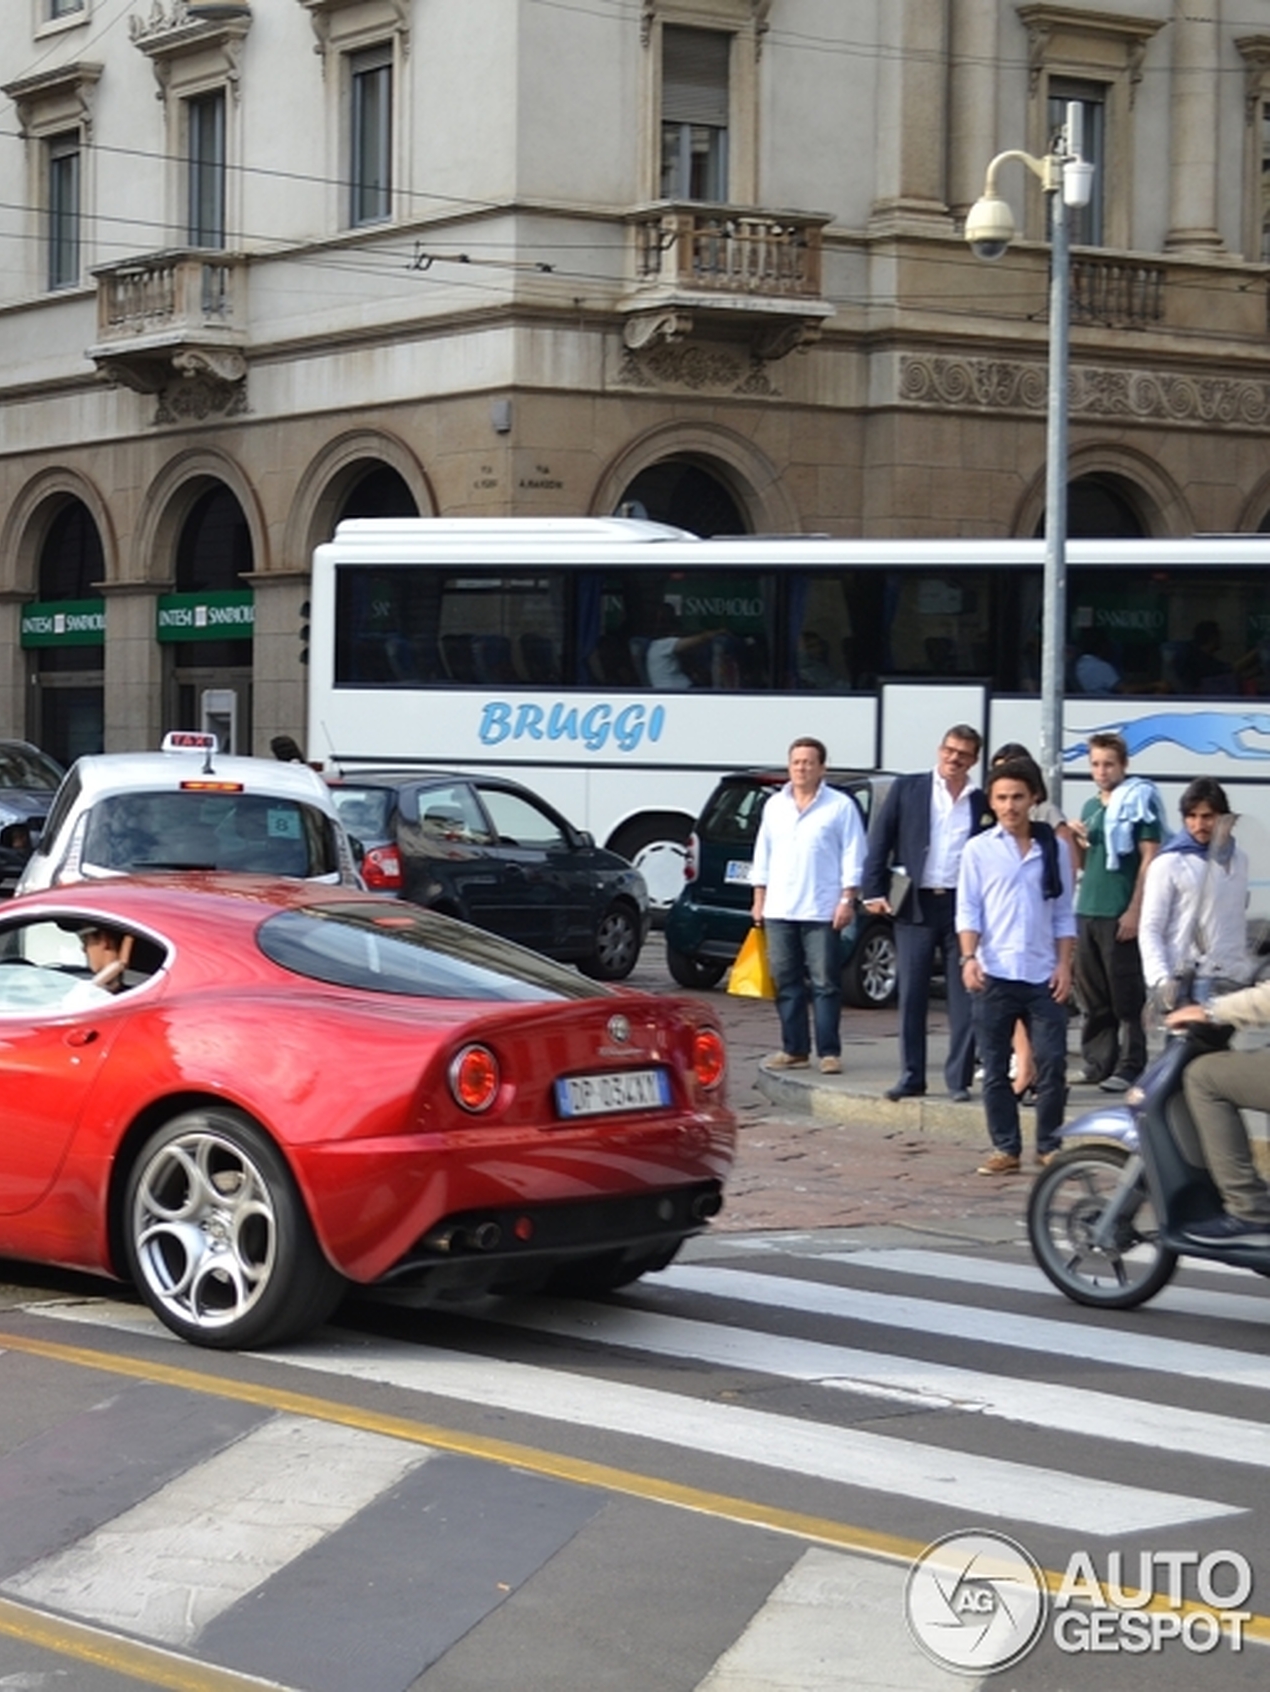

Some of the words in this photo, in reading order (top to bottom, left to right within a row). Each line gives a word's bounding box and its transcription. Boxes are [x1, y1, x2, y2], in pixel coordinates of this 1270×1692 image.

[66, 613, 106, 631] SANPAOL
[159, 607, 193, 626] INTESA
[479, 700, 666, 752] BRUGGI
[275, 818, 289, 831] 8
